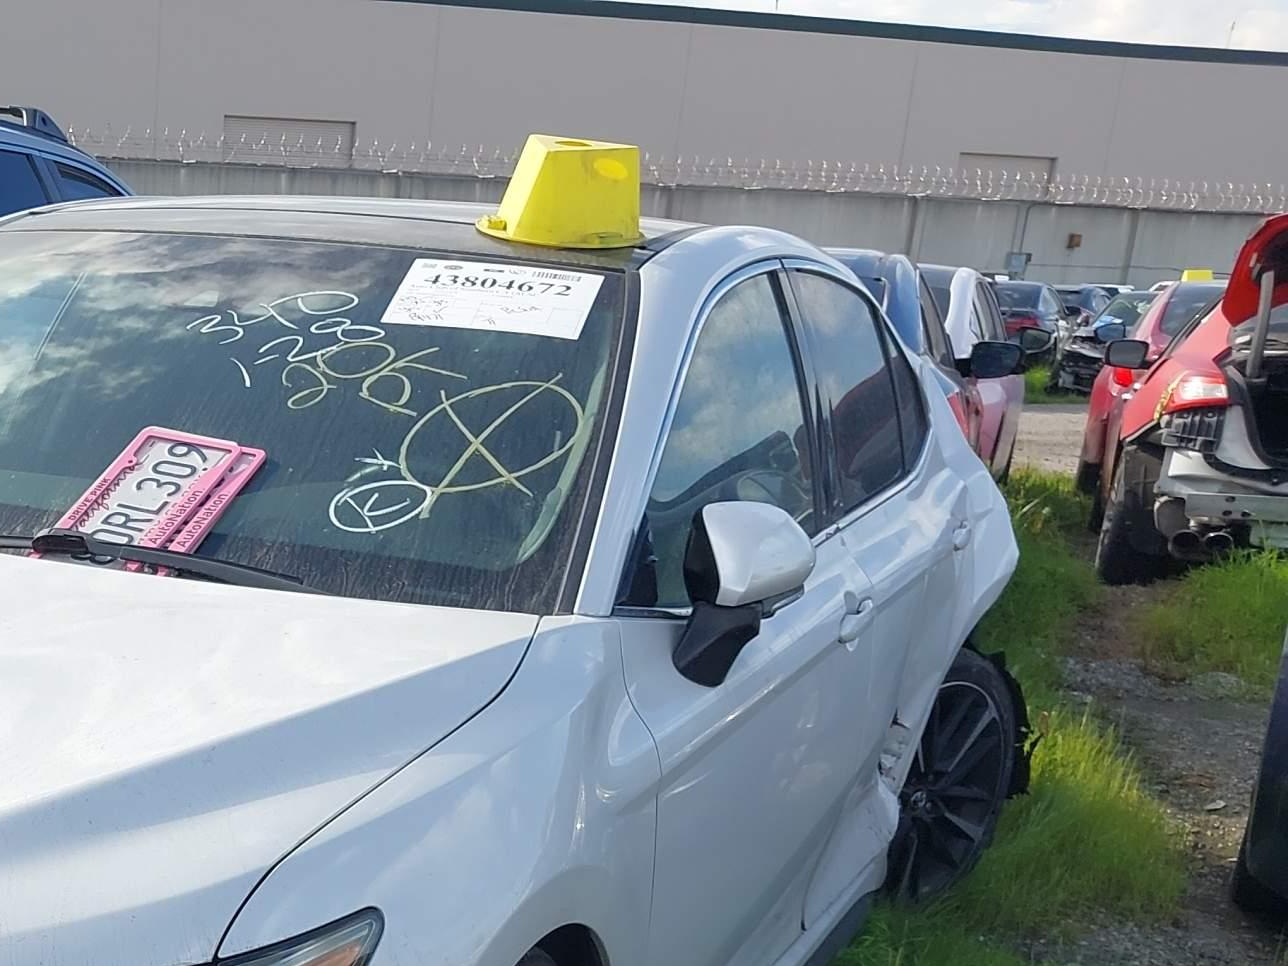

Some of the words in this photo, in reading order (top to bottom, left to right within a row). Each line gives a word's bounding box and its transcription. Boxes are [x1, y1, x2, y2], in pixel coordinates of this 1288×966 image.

[423, 274, 573, 297] 43804672
[68, 495, 94, 521] DRIVE
[89, 477, 112, 498] PINK
[149, 489, 205, 544] AutoNation
[176, 493, 230, 548] AutoNation
